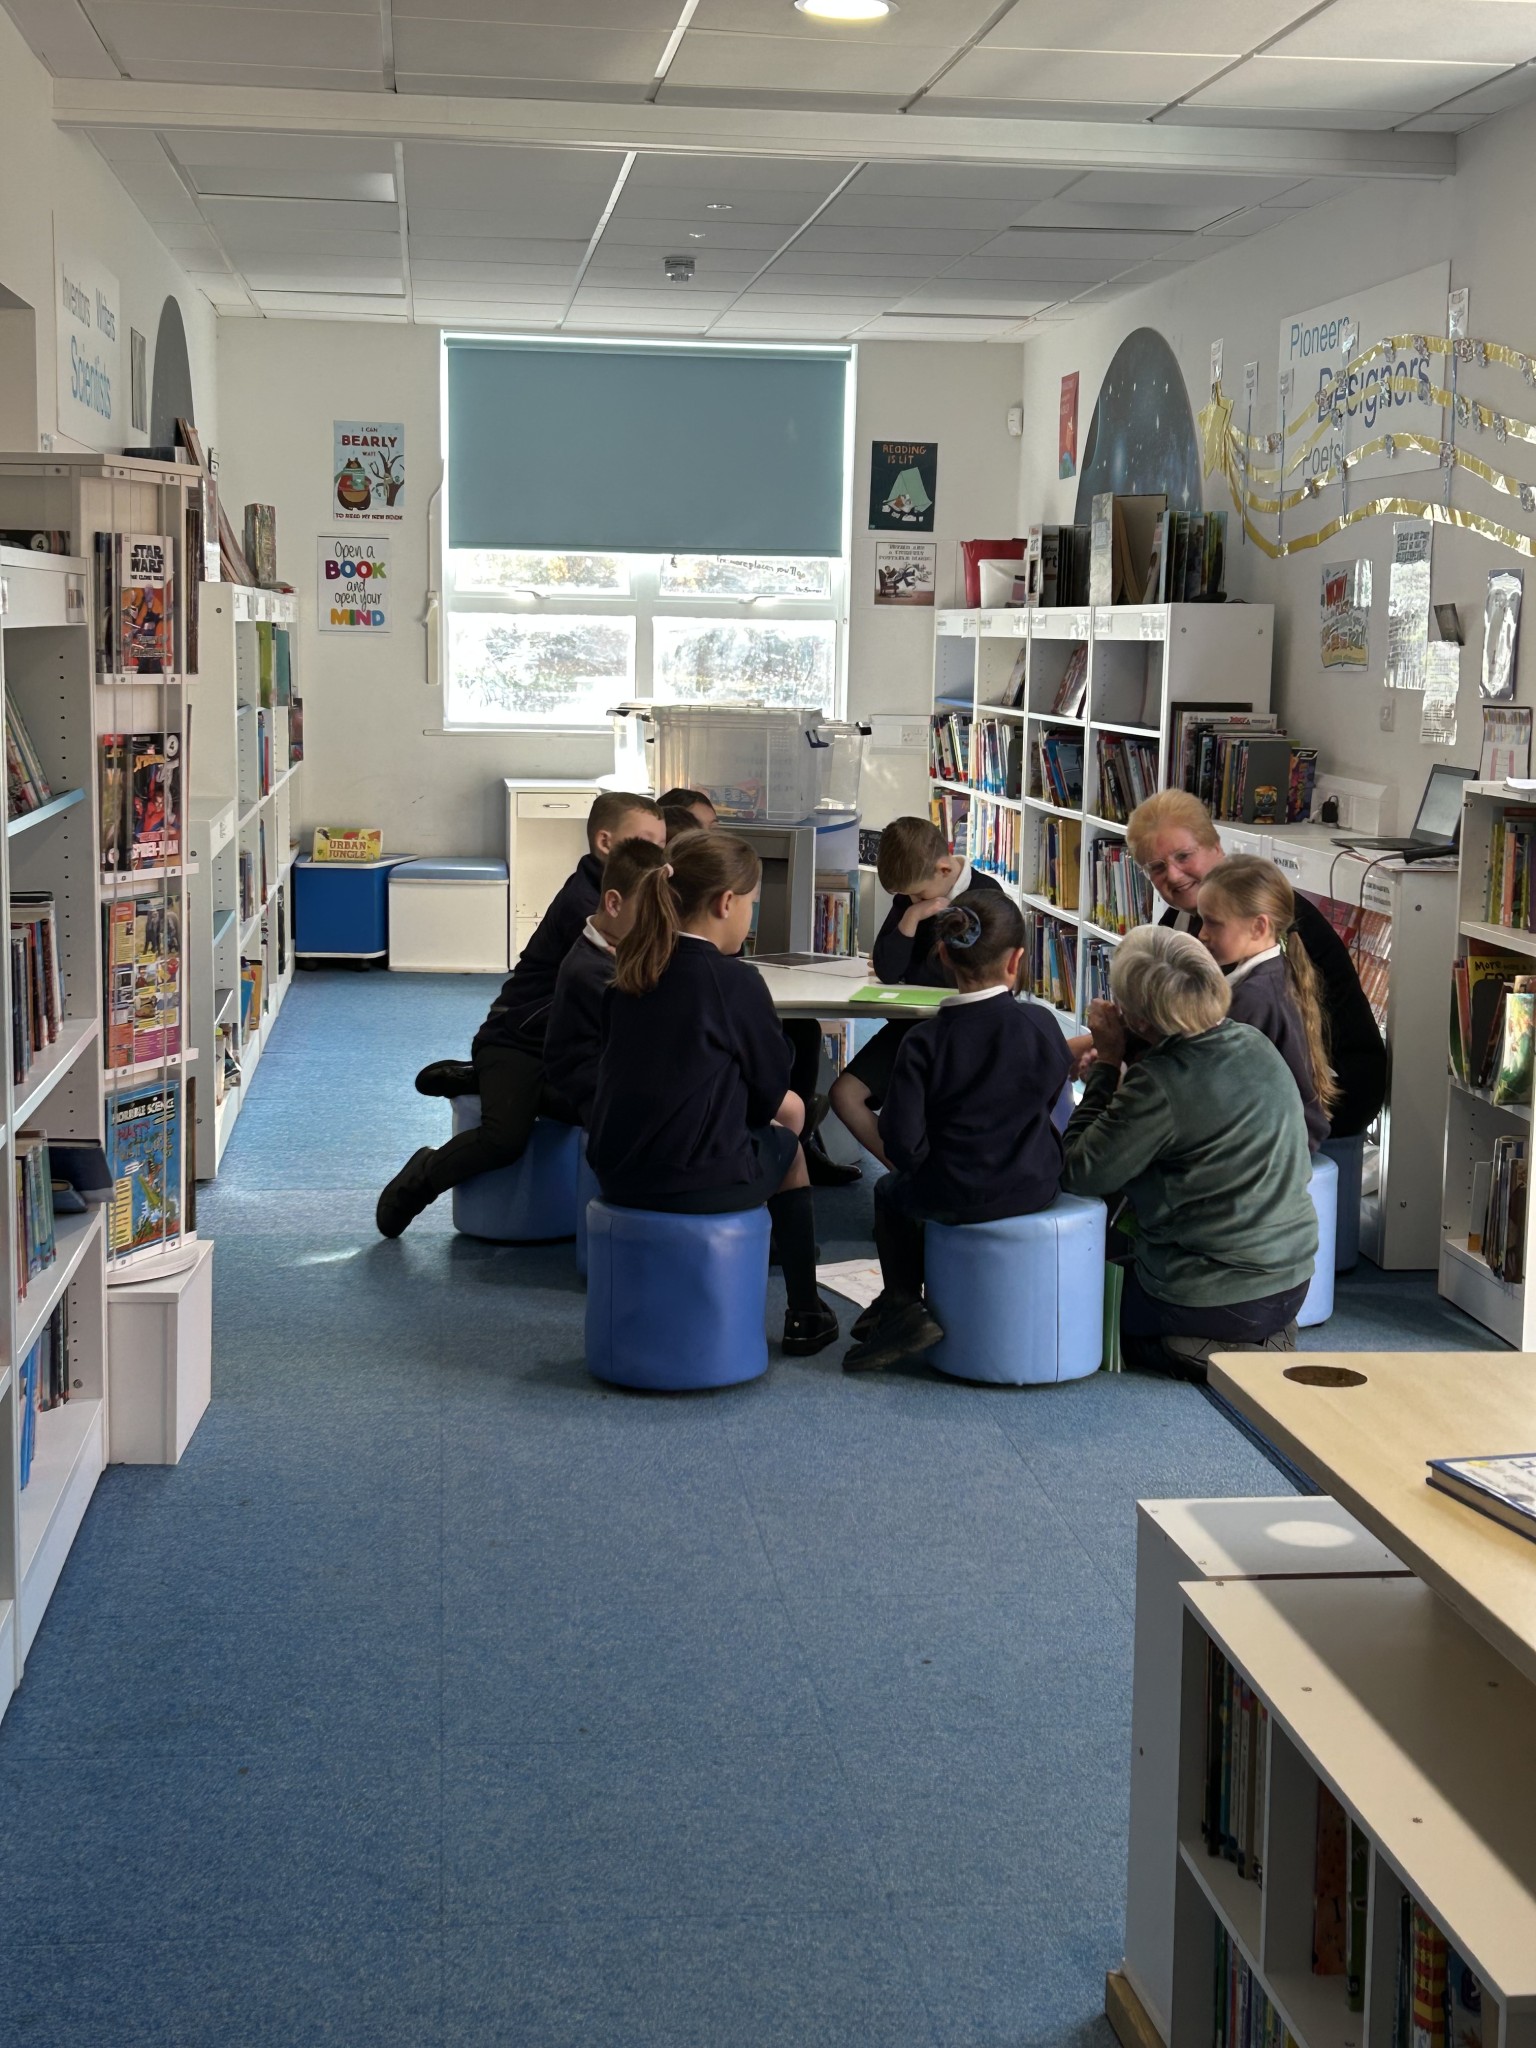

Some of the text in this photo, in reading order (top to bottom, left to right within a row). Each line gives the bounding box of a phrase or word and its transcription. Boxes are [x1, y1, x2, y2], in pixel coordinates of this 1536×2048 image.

[71, 335, 112, 419] Scientists
[341, 434, 398, 448] BEARLY
[882, 444, 927, 455] READING
[887, 455, 915, 464] IS LIT
[37, 540, 44, 551] 4
[131, 544, 164, 558] STAR
[335, 541, 375, 561] Open a
[131, 558, 164, 573] WARS
[325, 560, 387, 580] BOOK
[346, 579, 366, 593] and
[335, 592, 382, 612] open your
[330, 608, 385, 626] MIND
[329, 840, 367, 849] URBAN
[329, 849, 367, 859] JUNGLE
